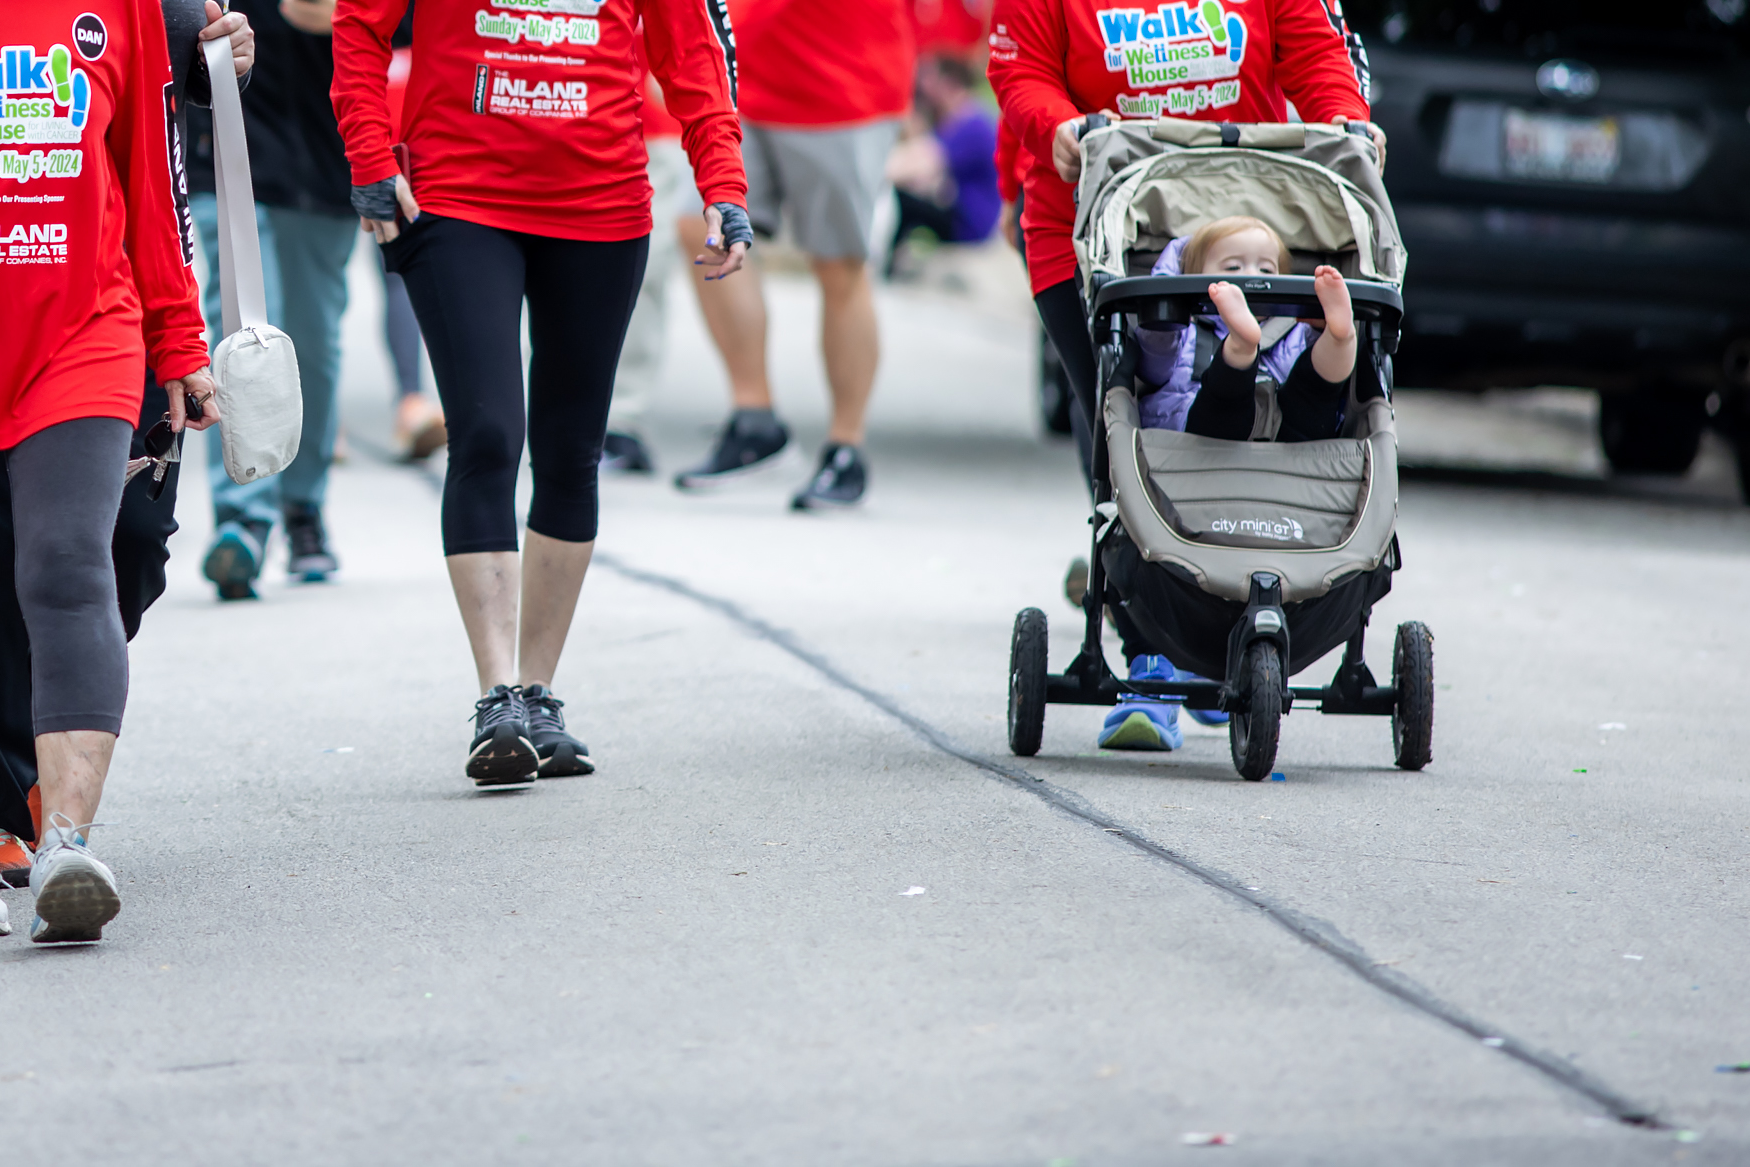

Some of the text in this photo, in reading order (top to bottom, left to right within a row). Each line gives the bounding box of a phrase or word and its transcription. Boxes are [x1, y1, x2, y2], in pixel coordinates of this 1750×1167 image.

[479, 15, 596, 42] Sunday May 5 2024
[1102, 6, 1205, 44] Walk
[77, 28, 103, 45] DAN
[1108, 52, 1122, 67] for
[1125, 44, 1209, 66] Wellness
[1131, 66, 1188, 85] House
[492, 77, 588, 99] INLAND
[491, 95, 588, 111] REAL ESTATE
[1119, 84, 1237, 115] Sunday May 5 2024
[42, 121, 66, 130] LIVING
[47, 131, 78, 140] CANCER
[3, 155, 29, 179] May
[33, 155, 40, 173] 5
[51, 154, 79, 173] 2024
[2, 195, 13, 203] Our
[14, 195, 43, 204] Presenting
[9, 244, 68, 256] ESTATE
[6, 257, 53, 265] COMPANIES,
[1212, 518, 1237, 534] city
[1274, 524, 1289, 534] GT
